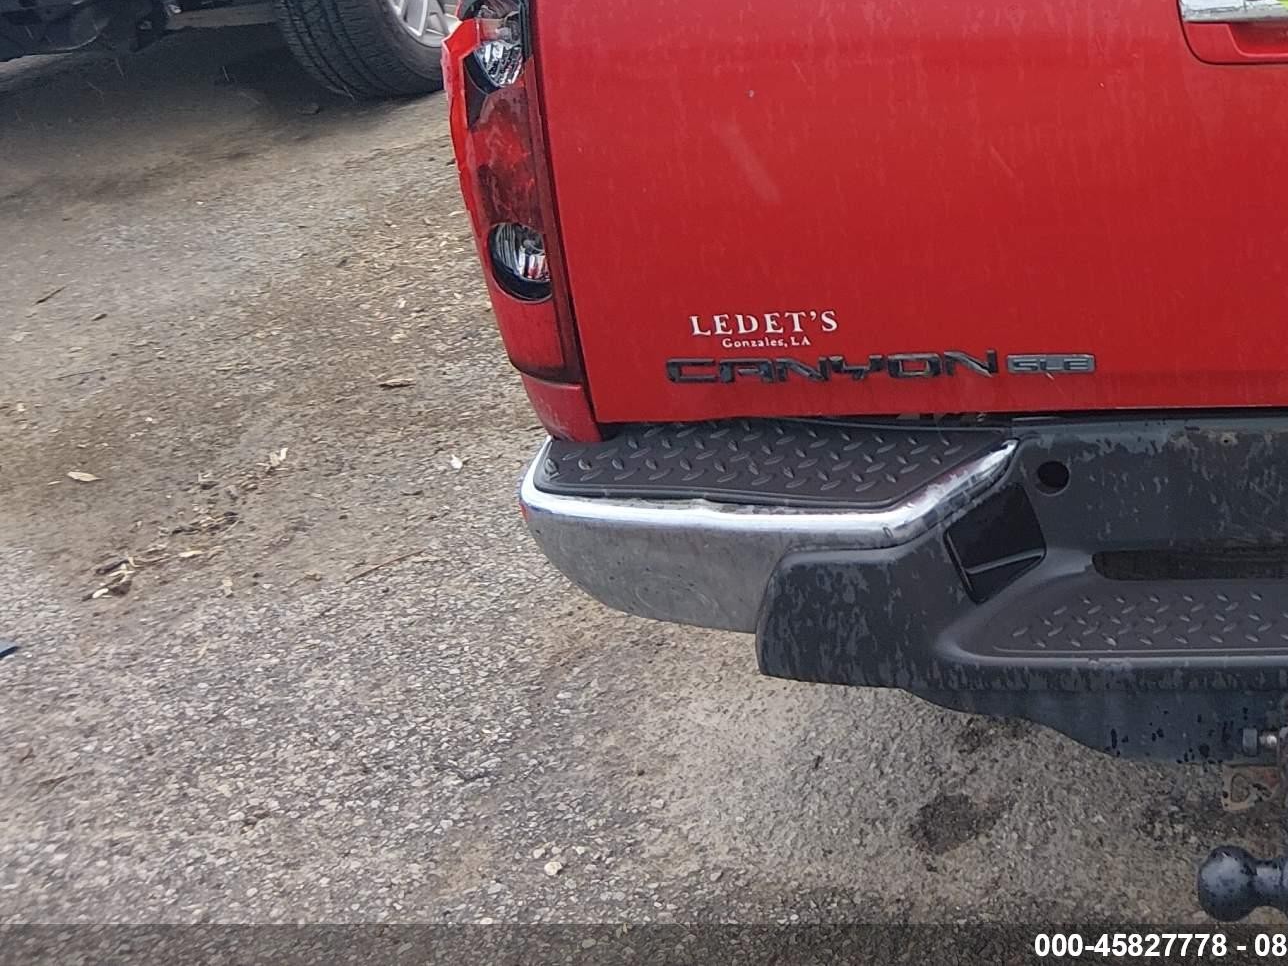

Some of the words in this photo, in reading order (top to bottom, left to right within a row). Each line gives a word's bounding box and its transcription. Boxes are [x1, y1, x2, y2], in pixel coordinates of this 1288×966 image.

[689, 310, 839, 336] LEDET'S
[721, 337, 788, 349] Gonzales,
[790, 336, 812, 347] LA
[665, 349, 999, 383] CANYON
